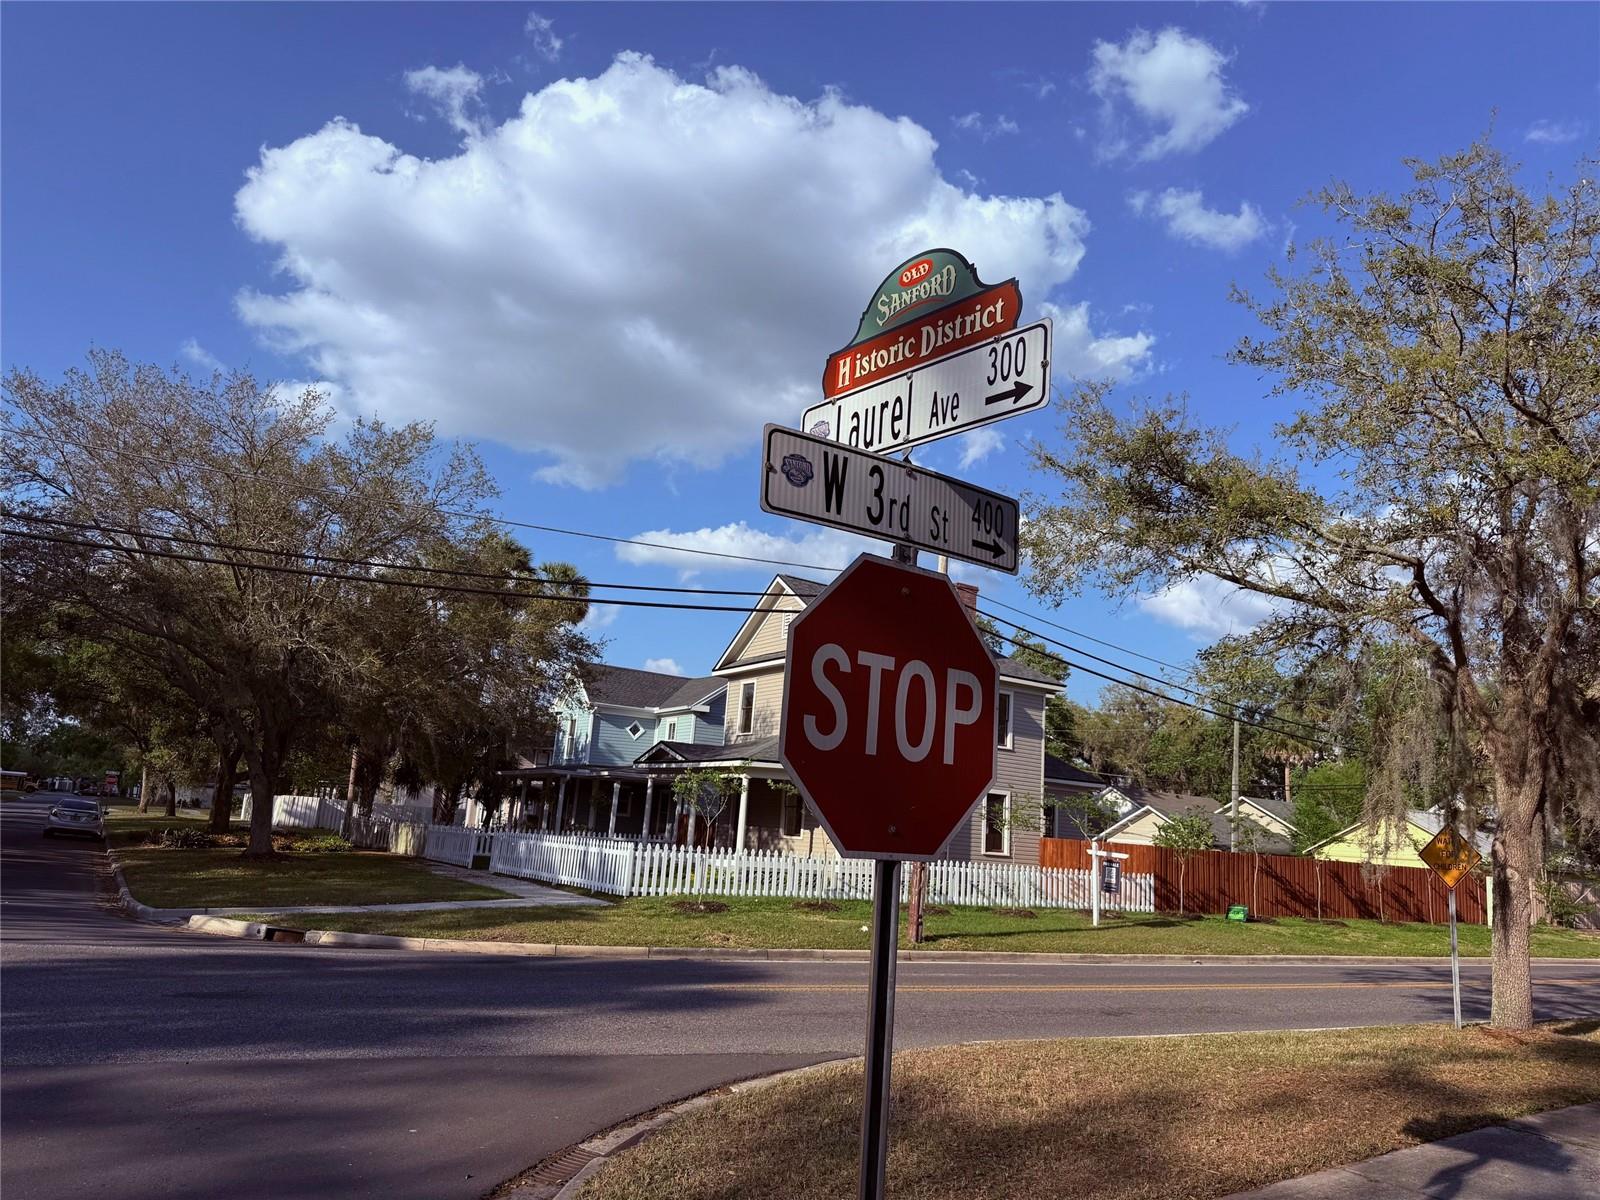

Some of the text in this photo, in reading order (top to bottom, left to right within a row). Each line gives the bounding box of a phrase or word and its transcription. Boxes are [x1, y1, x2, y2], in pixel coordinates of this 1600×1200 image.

[876, 264, 957, 327] SANFORD
[902, 262, 930, 284] OLD
[837, 297, 1005, 389] Historic District
[986, 336, 1027, 386] 300
[928, 391, 960, 429] Ave
[823, 451, 1005, 544] W 3rd St 400
[803, 643, 983, 765] STOP
[1433, 863, 1467, 871] CHILDREN
